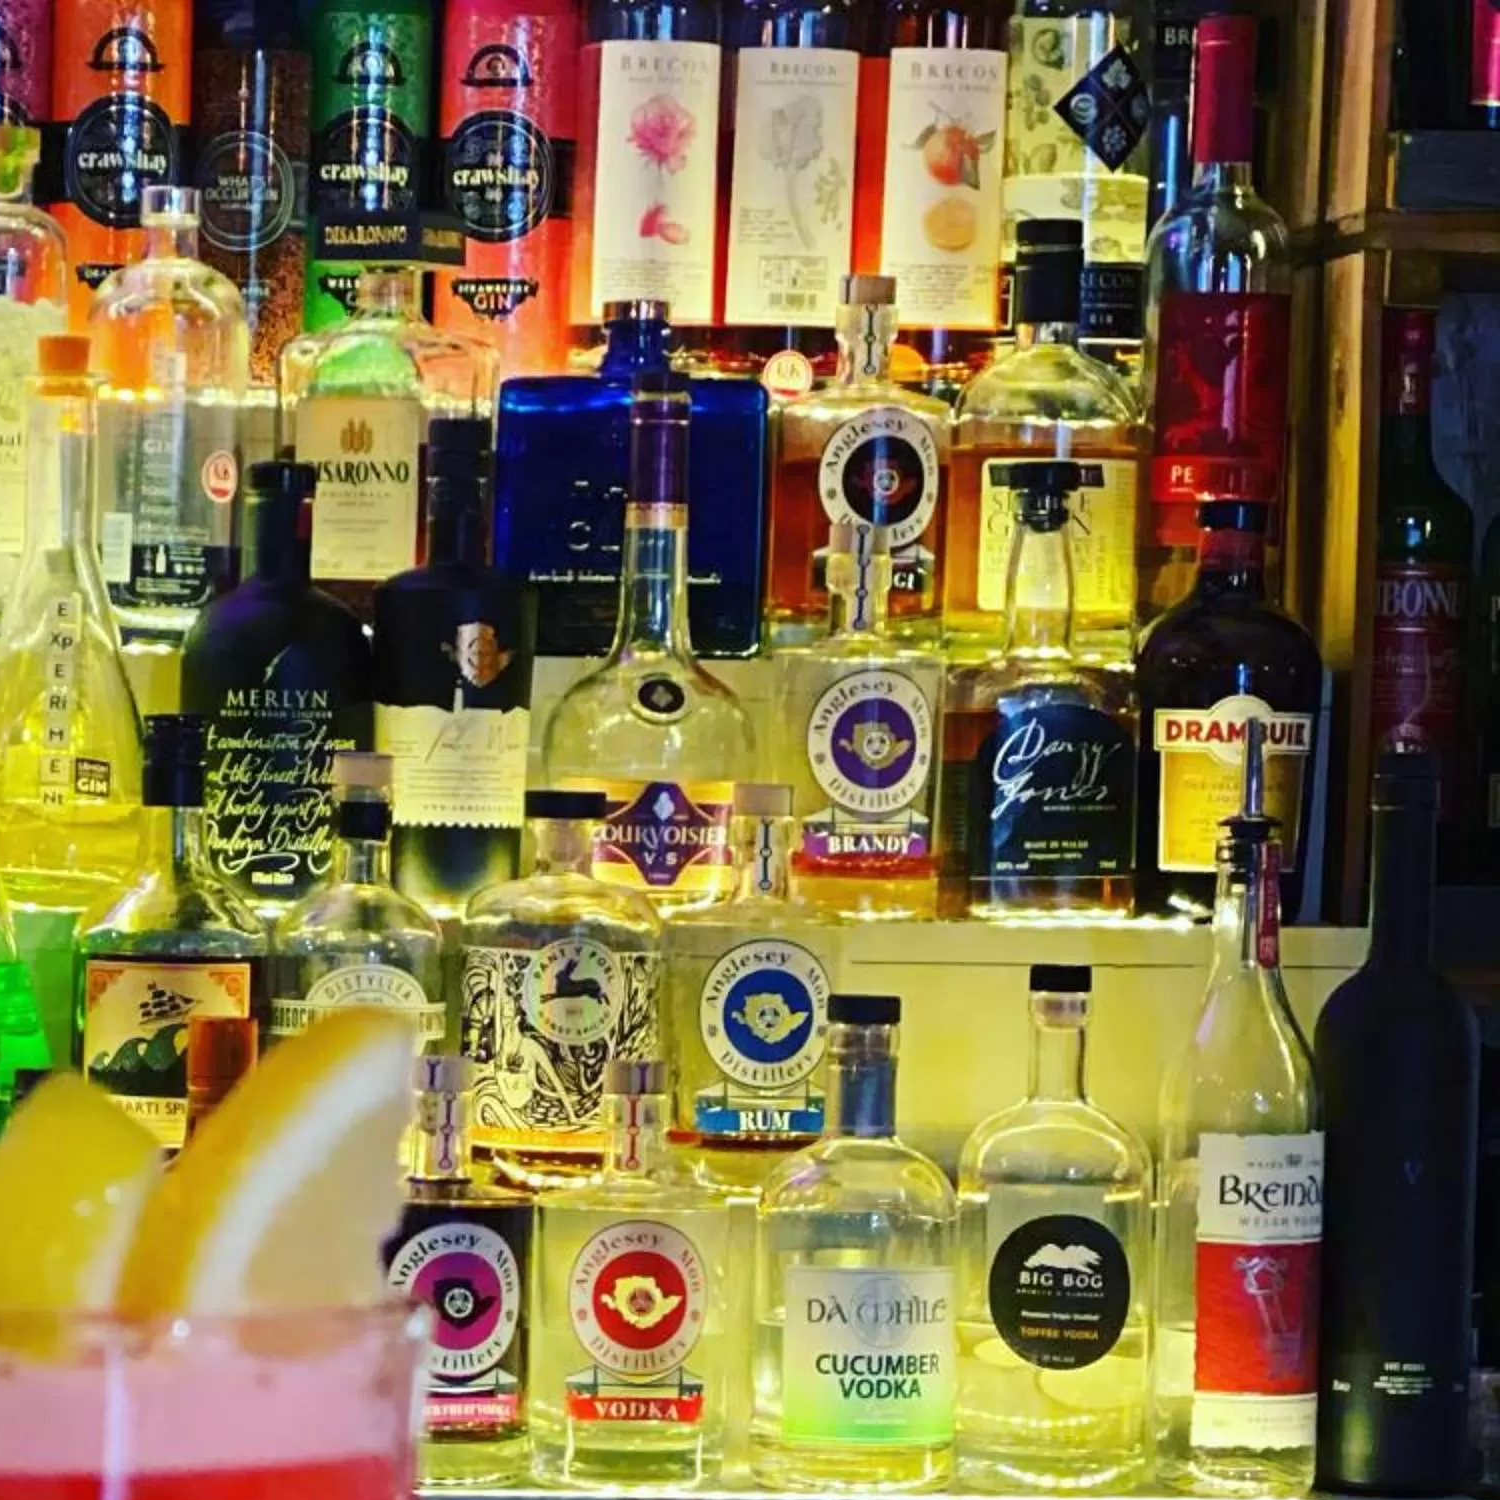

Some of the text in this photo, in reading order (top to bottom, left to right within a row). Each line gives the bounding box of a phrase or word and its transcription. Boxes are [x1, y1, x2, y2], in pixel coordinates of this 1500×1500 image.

[320, 162, 410, 187] crawshay
[324, 225, 408, 246] DISARONNO
[473, 294, 512, 311] GIN
[226, 688, 329, 709] MERLYN
[827, 834, 911, 854] BRANDY
[705, 949, 791, 1009] Anglesey
[720, 1050, 814, 1083] Distillery
[739, 1110, 791, 1131] RUM
[1019, 1271, 1104, 1289] BIG BOG
[431, 1339, 503, 1370] stillery
[814, 1353, 941, 1377] CUCUMBER
[838, 1377, 923, 1400] VODKA
[593, 1400, 680, 1421] VODKA
